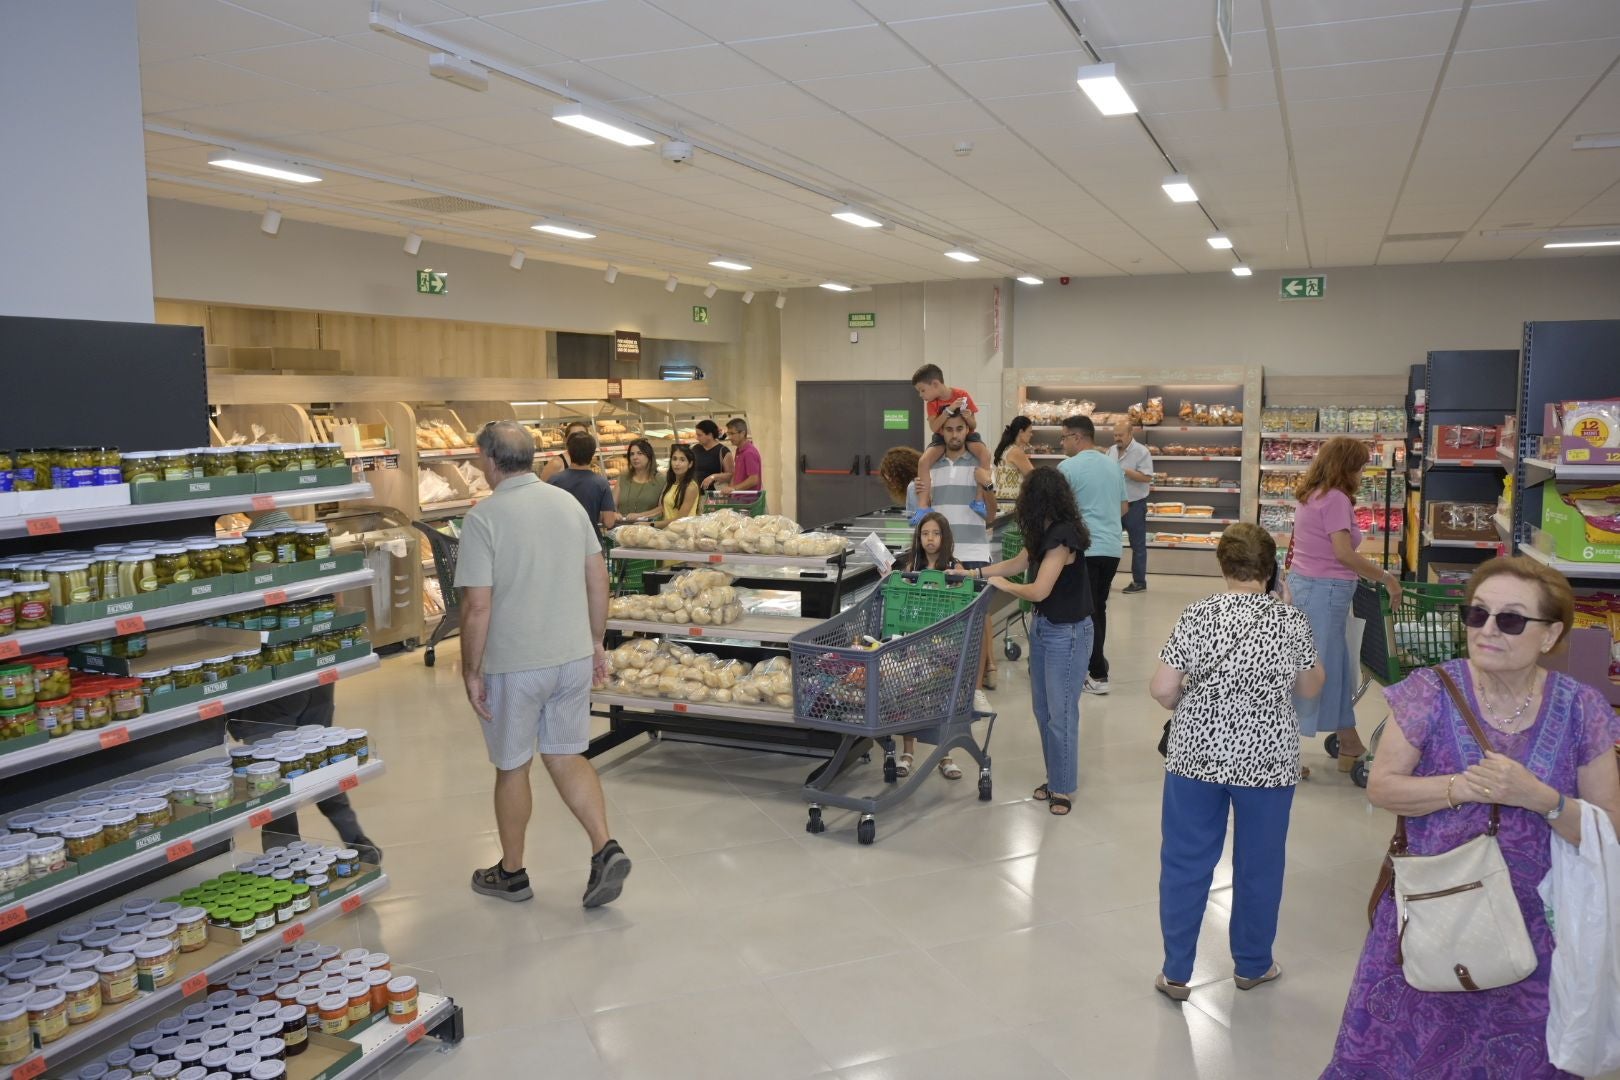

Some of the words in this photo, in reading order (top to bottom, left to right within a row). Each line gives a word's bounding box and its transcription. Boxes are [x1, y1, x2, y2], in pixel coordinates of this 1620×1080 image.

[1582, 421, 1599, 430] 12
[1605, 453, 1620, 462] 12
[1583, 546, 1594, 559] 6
